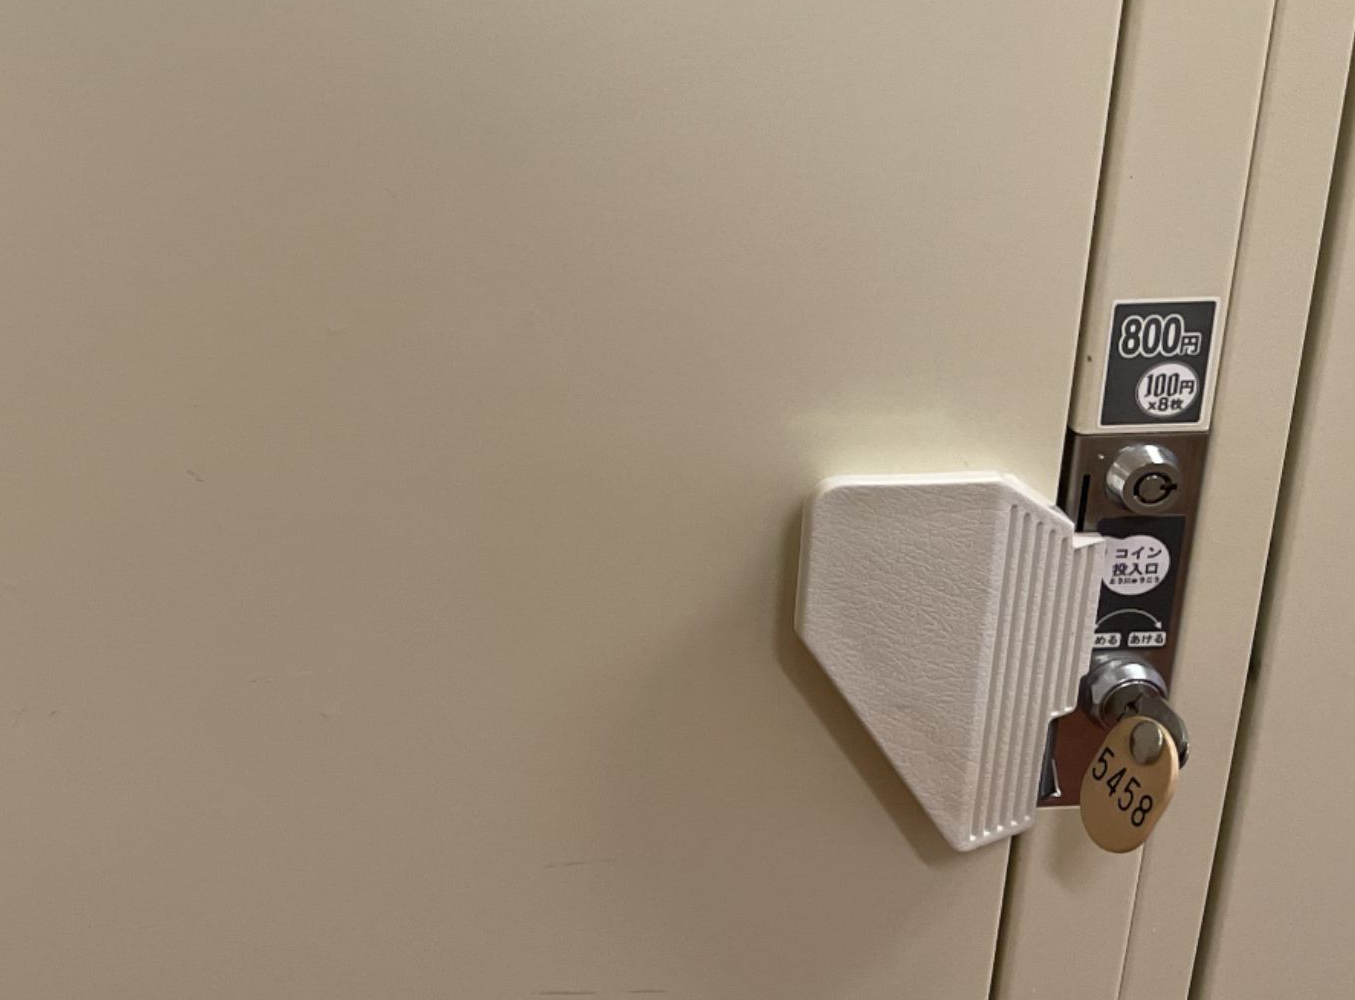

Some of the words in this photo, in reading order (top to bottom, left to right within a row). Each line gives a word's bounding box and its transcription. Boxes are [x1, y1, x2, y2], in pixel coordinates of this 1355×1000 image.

[1118, 313, 1202, 358] 800円
[1144, 372, 1195, 398] 100円
[1115, 546, 1162, 560] コイン
[1112, 562, 1159, 577] 投入口
[1091, 746, 1154, 828] 5458
